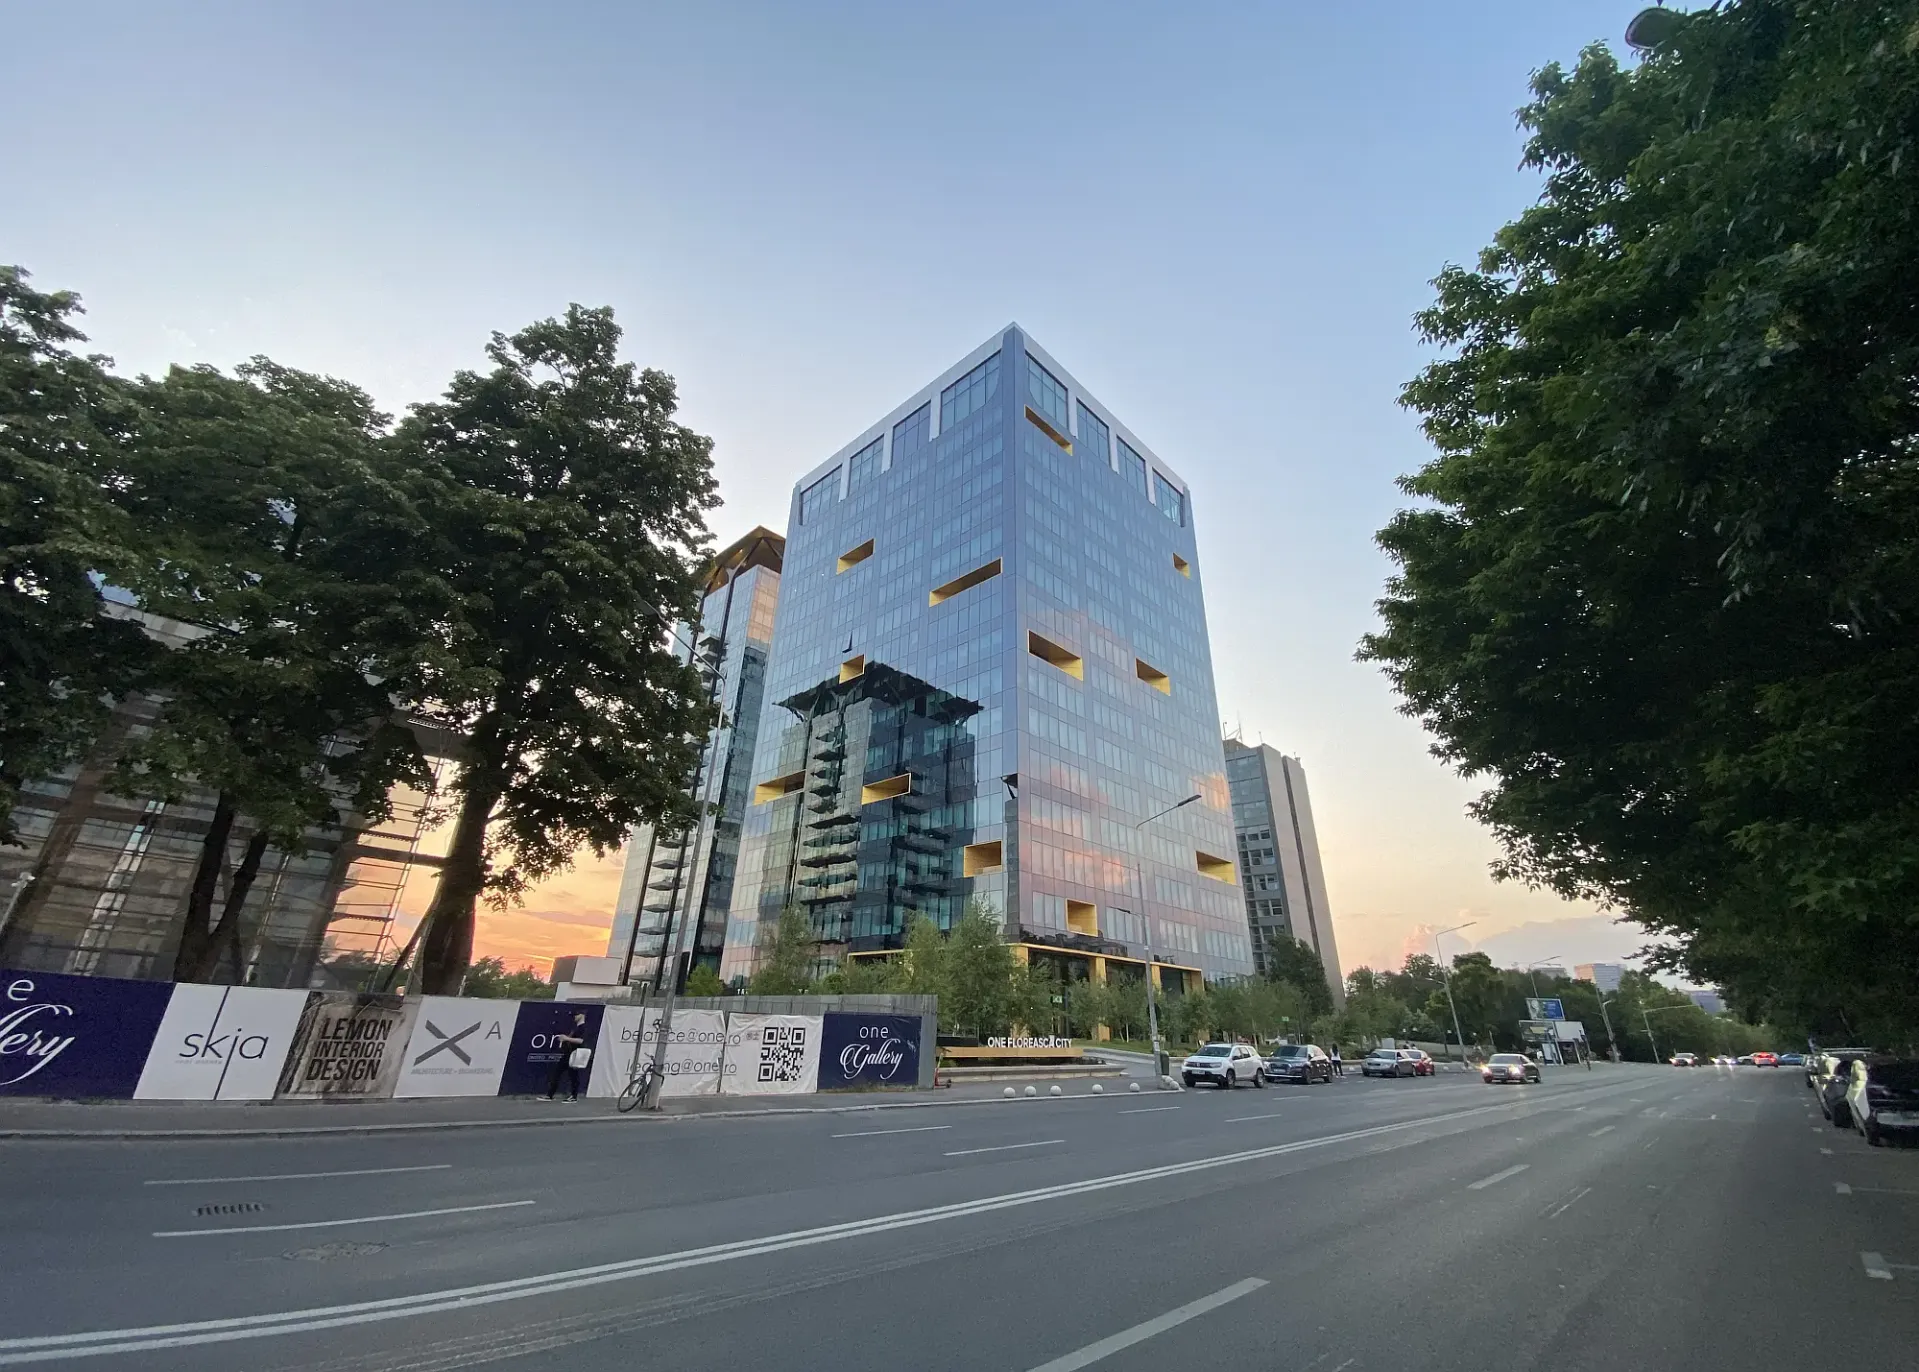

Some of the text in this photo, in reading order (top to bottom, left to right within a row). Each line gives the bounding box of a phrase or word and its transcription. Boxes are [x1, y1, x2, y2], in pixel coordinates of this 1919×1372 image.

[320, 1017, 393, 1040] LEMON
[620, 1026, 741, 1045] beatce@one.ro
[859, 1026, 889, 1039] one
[313, 1041, 386, 1058] INTERIOR
[531, 1033, 563, 1049] on
[987, 1034, 1073, 1049] ONE FLOREASCA CITY
[626, 1058, 737, 1076] leang@onero
[839, 1037, 904, 1080] Gallery
[306, 1058, 382, 1081] DESIGN
